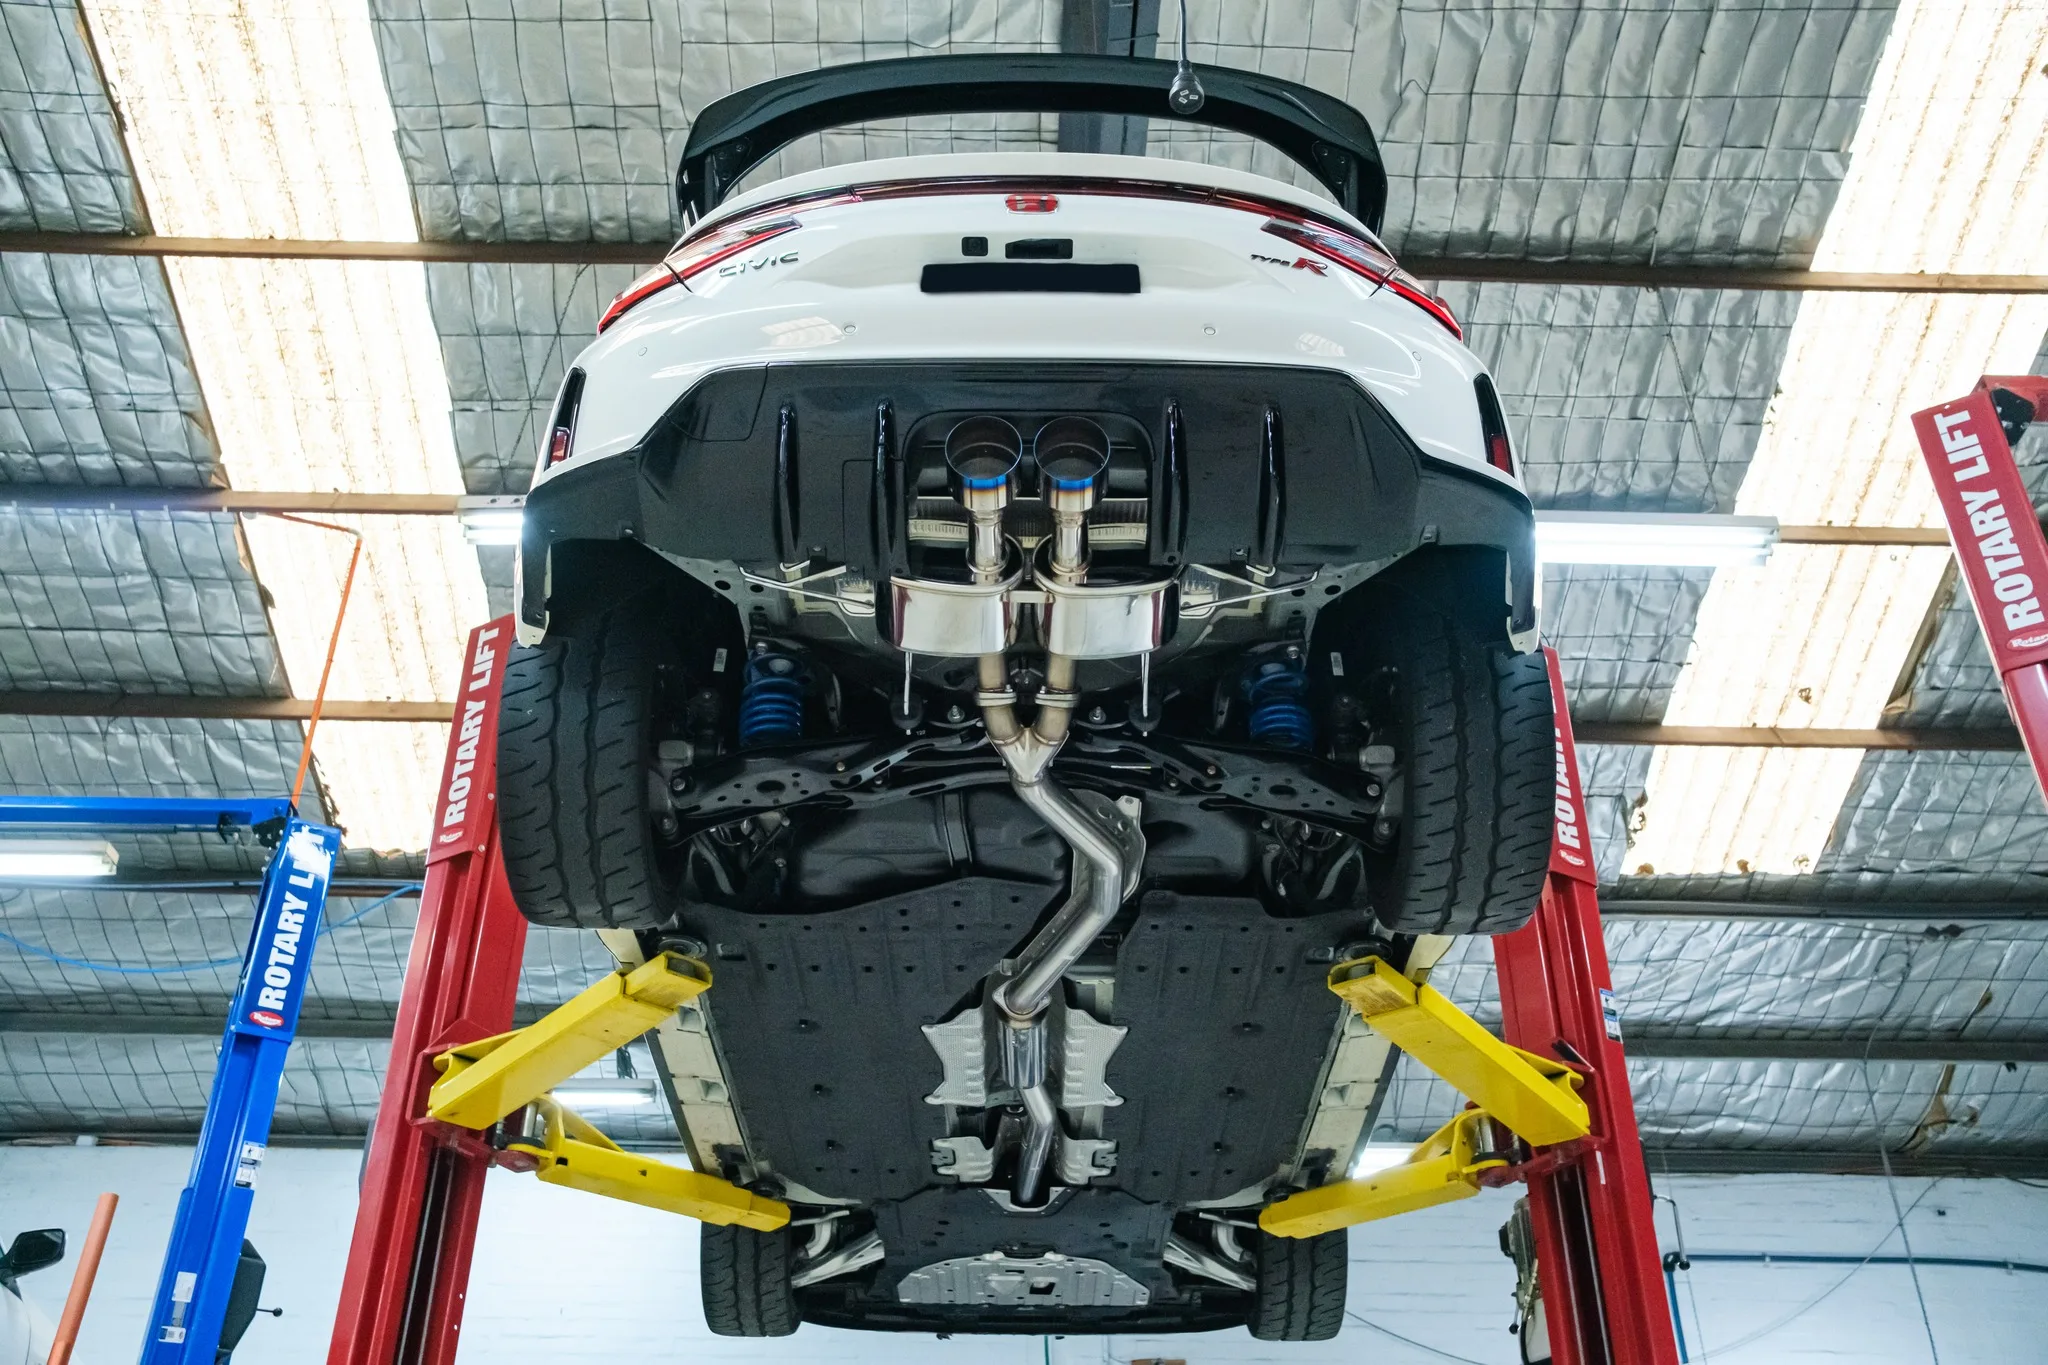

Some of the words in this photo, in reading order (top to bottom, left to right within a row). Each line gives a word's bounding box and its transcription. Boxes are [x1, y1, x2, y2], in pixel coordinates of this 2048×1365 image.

[719, 251, 799, 278] CIVIC
[1250, 253, 1291, 267] TYPE
[1291, 256, 1329, 277] R
[1934, 409, 1990, 482] LIFT
[1960, 488, 2045, 631] ROTARY
[443, 700, 486, 828] ROTARY
[469, 626, 500, 692] LIFT
[1555, 727, 1581, 849] ROTA
[258, 891, 309, 1011] ROTARY
